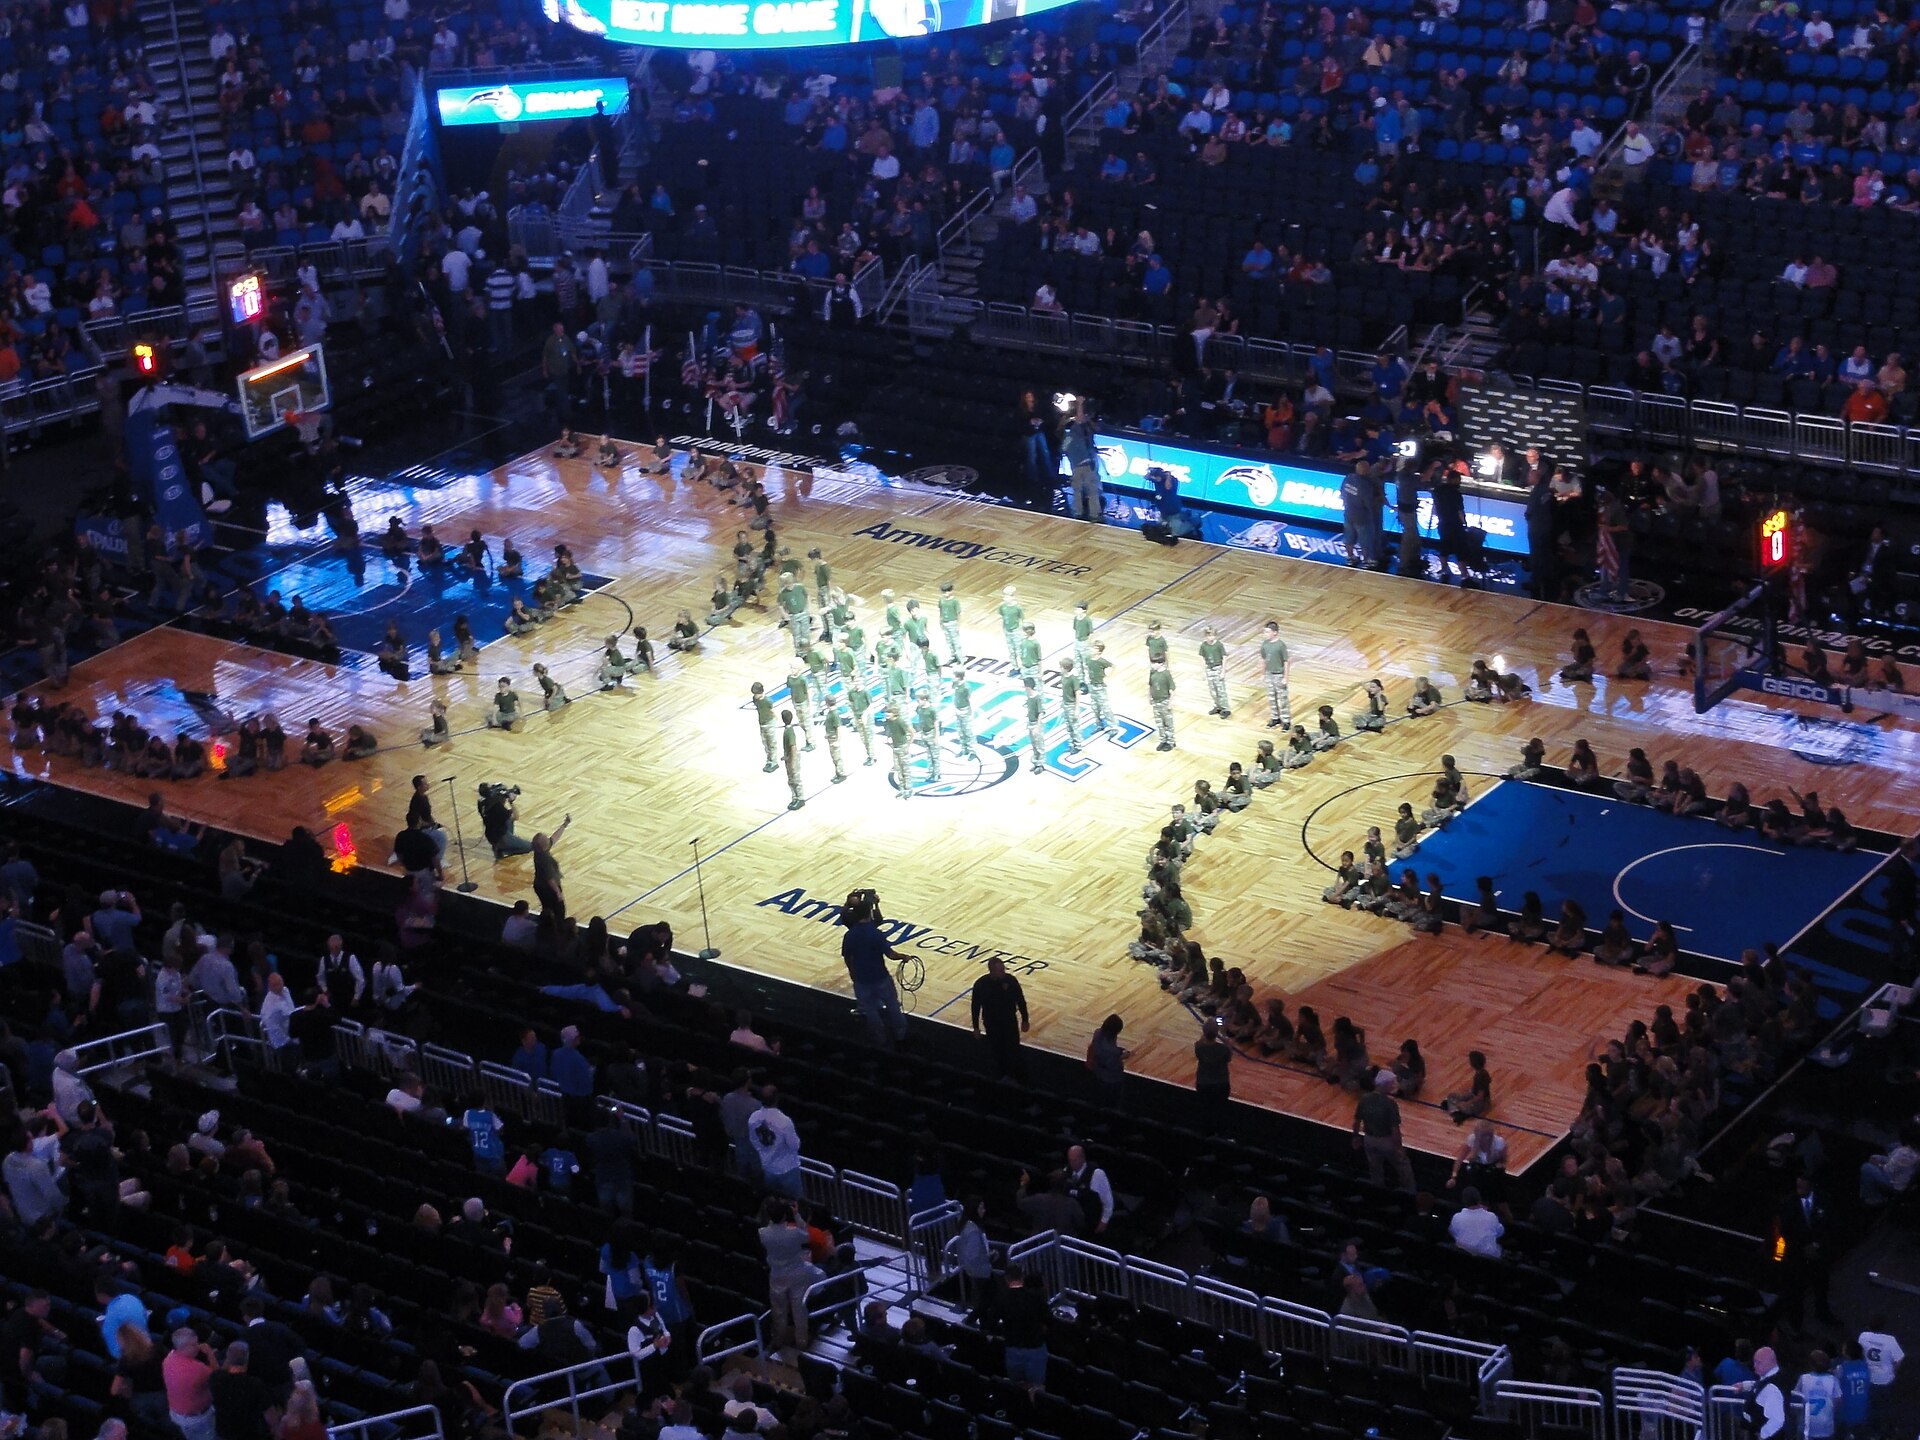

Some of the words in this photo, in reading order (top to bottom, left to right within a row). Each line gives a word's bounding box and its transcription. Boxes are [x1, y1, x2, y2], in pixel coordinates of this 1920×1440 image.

[611, 0, 669, 32] NEXT
[671, 4, 751, 35] HOME
[753, 0, 839, 34] GAME
[1762, 677, 1828, 702] GEICO
[473, 1130, 489, 1149] 12
